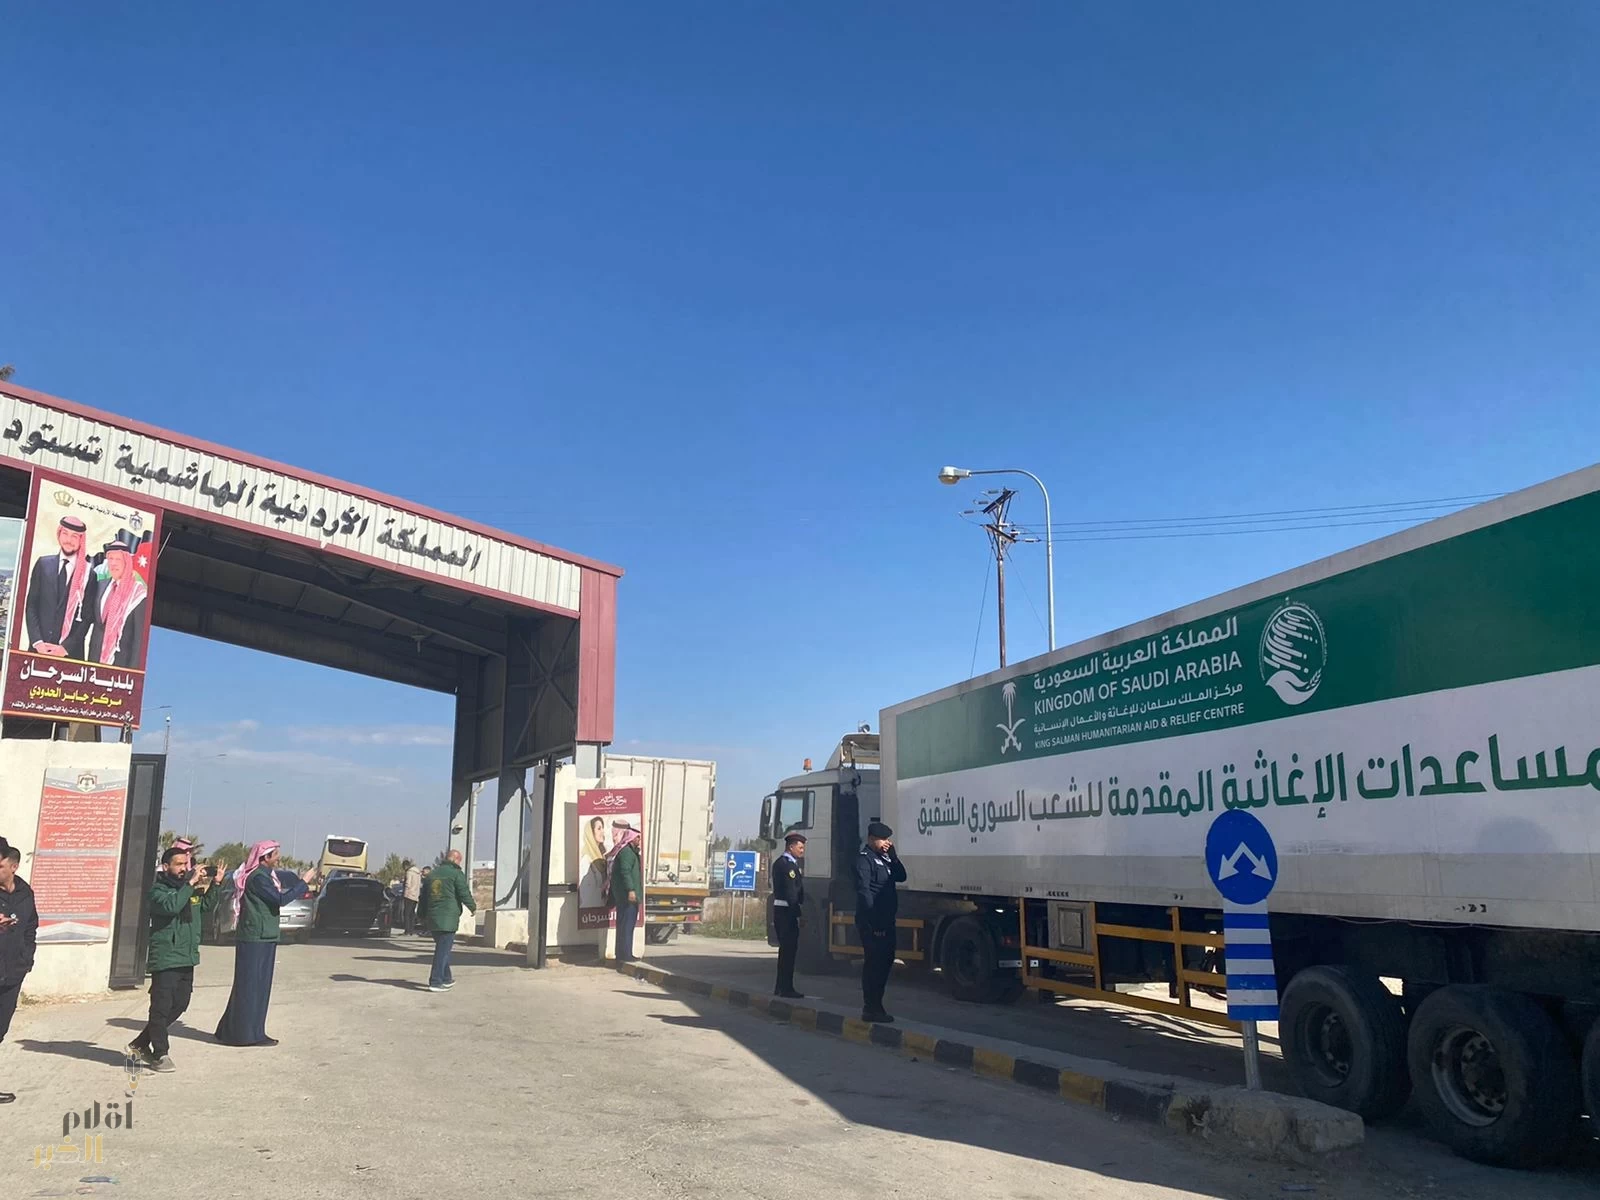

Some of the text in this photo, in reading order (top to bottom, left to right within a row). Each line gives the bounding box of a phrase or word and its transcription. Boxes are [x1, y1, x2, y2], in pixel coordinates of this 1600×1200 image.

[115, 444, 257, 508] الهاشمية
[259, 483, 370, 538] الأردنية
[376, 518, 482, 572] المملكة
[20, 659, 134, 695] بلدية السرحان
[1034, 615, 1238, 694] المملكة العربية السعودية
[29, 685, 122, 707] مركز جابر الحدودي
[1034, 650, 1242, 715] KINGDOM OF SAUDI ARABIA
[1034, 683, 1243, 736] مركز الملك سلمان للإغاثة والأعمال الإنسانية
[1034, 702, 1245, 749] KING SALMAN HUMANITARIAN AID & RELIEF CENTRE
[1029, 776, 1102, 831] للشعب
[1108, 769, 1213, 817] المقدمة
[1222, 749, 1347, 818] الإغاثية
[917, 792, 965, 835] الشقيق
[967, 789, 1025, 843] السوري
[582, 911, 617, 923] السرحان
